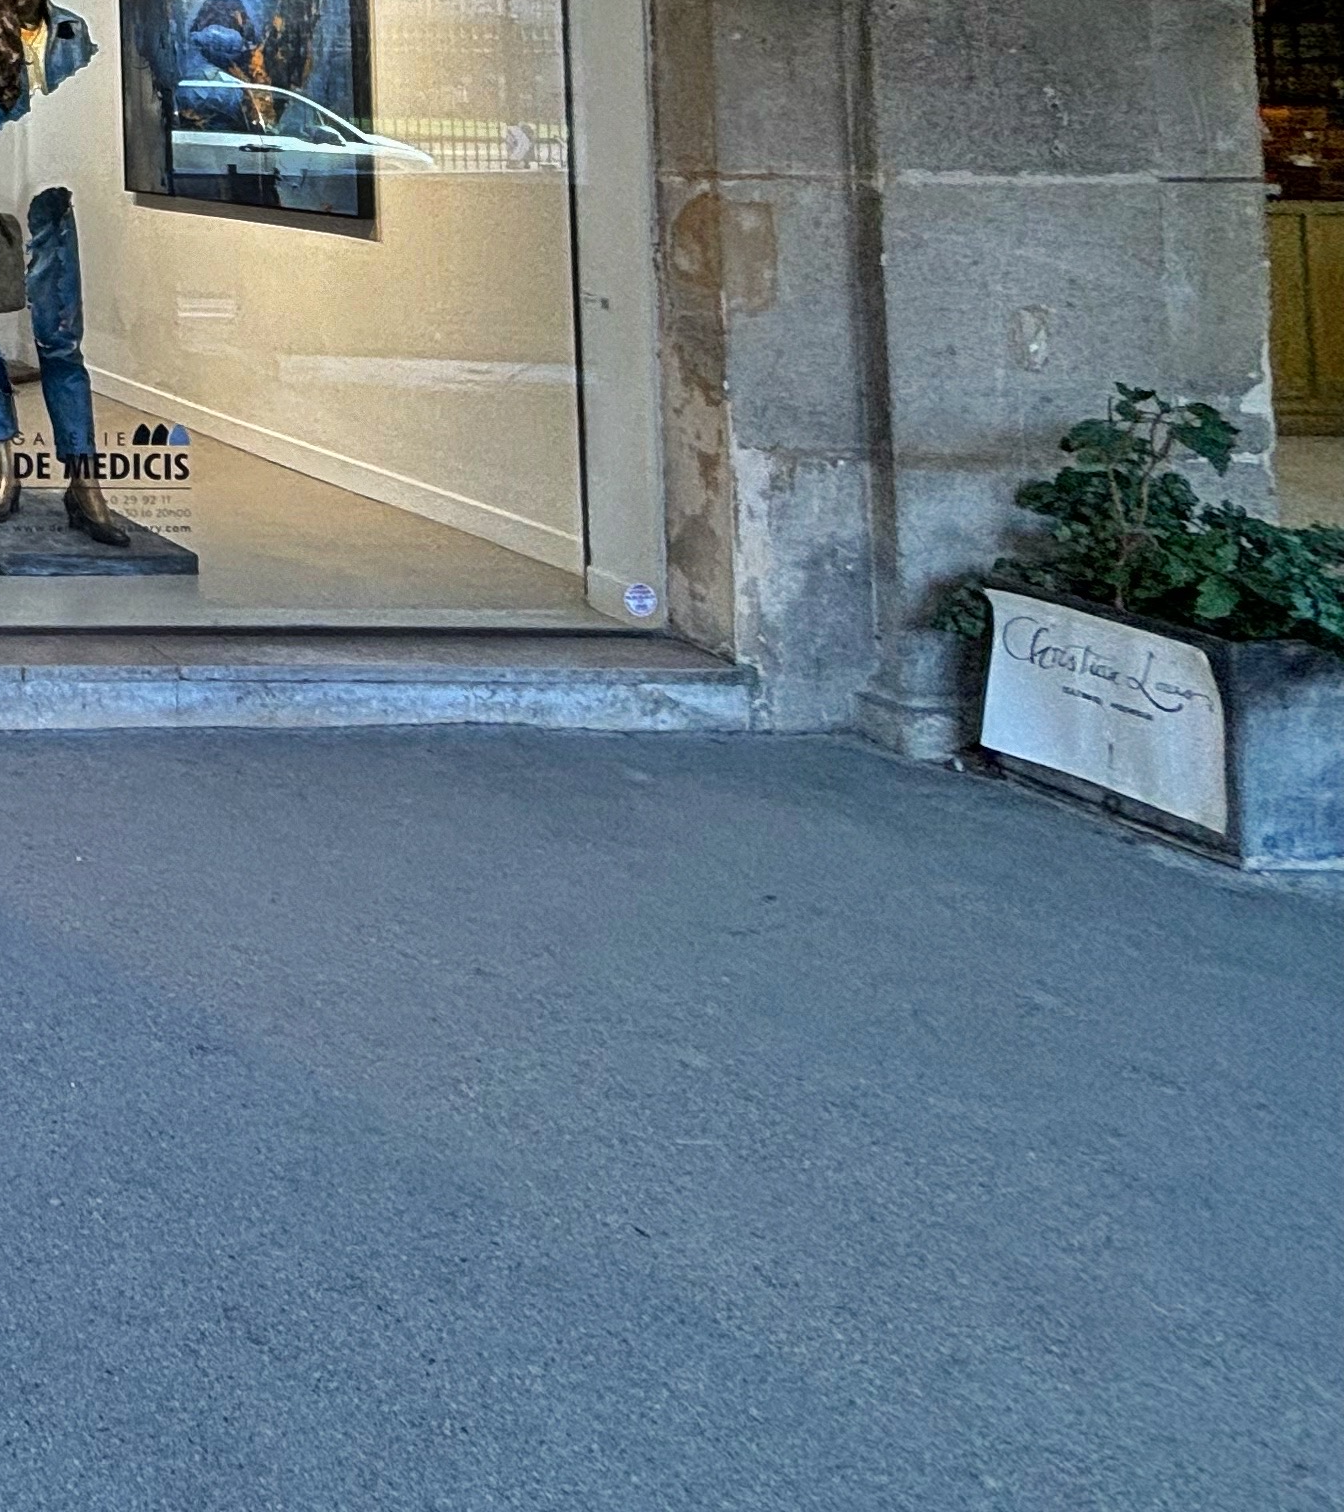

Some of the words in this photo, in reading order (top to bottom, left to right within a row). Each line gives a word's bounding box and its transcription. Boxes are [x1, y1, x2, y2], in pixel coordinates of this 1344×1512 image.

[13, 432, 127, 447] GAERIE
[13, 452, 52, 480] DE
[63, 452, 191, 481] MEDICIS
